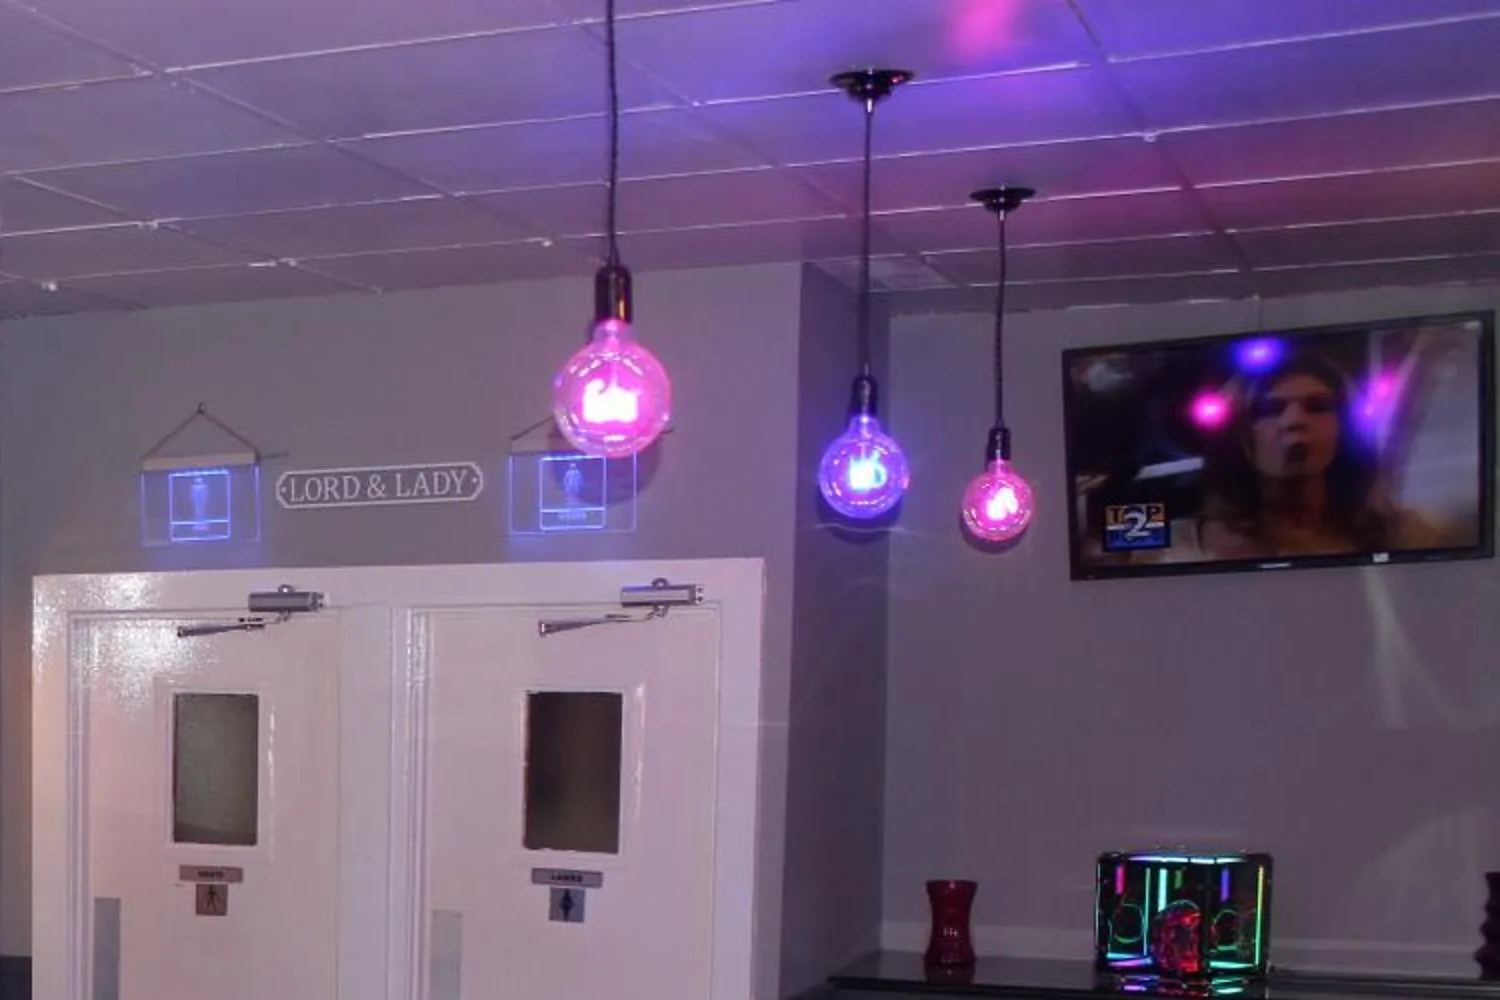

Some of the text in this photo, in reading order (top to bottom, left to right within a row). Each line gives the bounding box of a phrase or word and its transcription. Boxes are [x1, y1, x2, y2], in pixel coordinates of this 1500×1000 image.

[289, 469, 469, 502] LORD & LADY
[1123, 511, 1151, 541] 2
